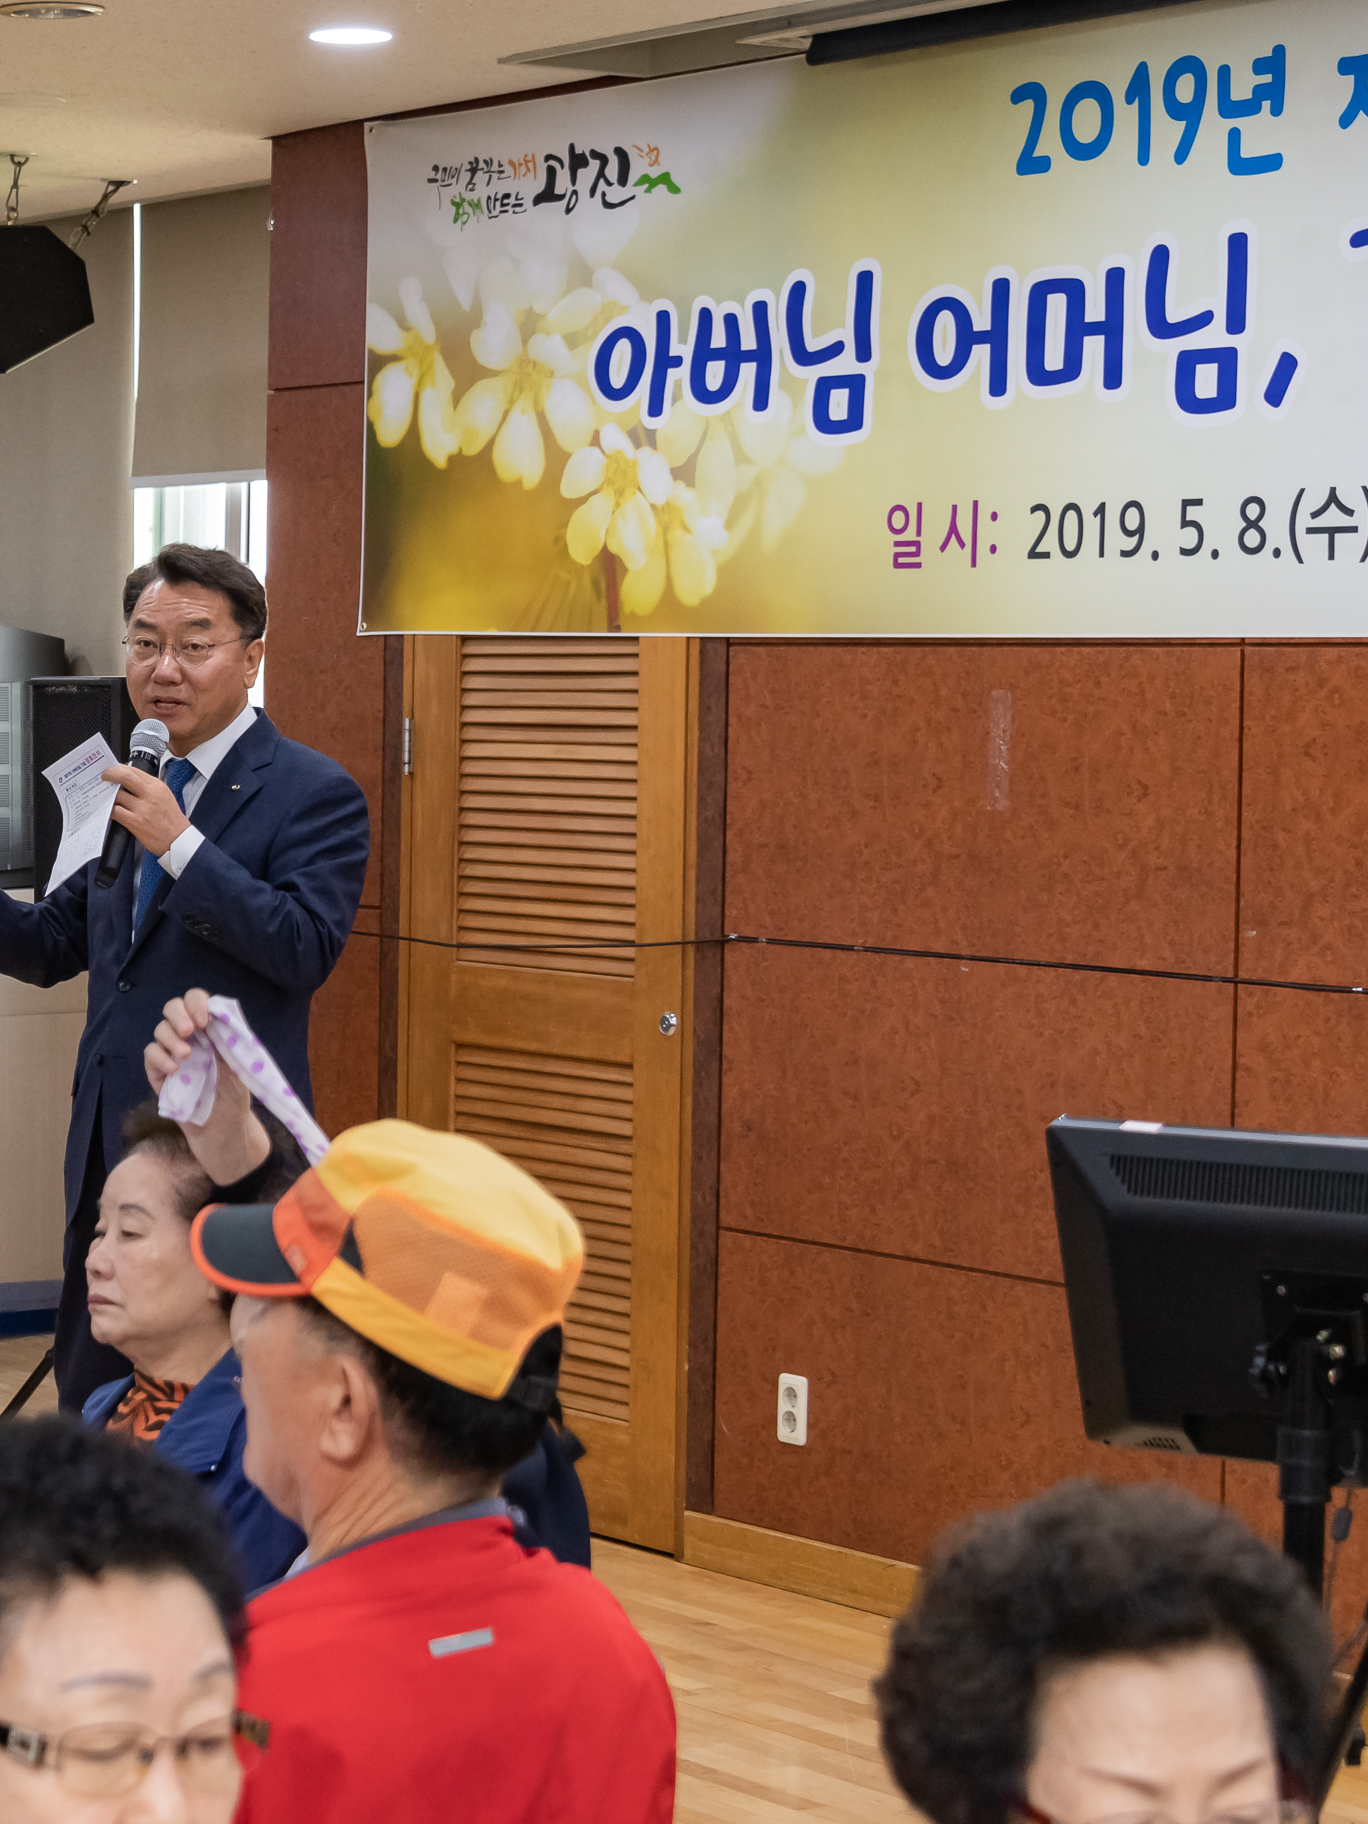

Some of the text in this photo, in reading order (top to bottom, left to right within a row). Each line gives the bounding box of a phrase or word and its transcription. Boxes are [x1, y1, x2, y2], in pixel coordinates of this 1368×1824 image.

[1010, 43, 1287, 177] 2019년
[485, 191, 527, 219] 만드는
[532, 142, 637, 216] 광진
[593, 231, 1298, 436] 아버님 어머님,
